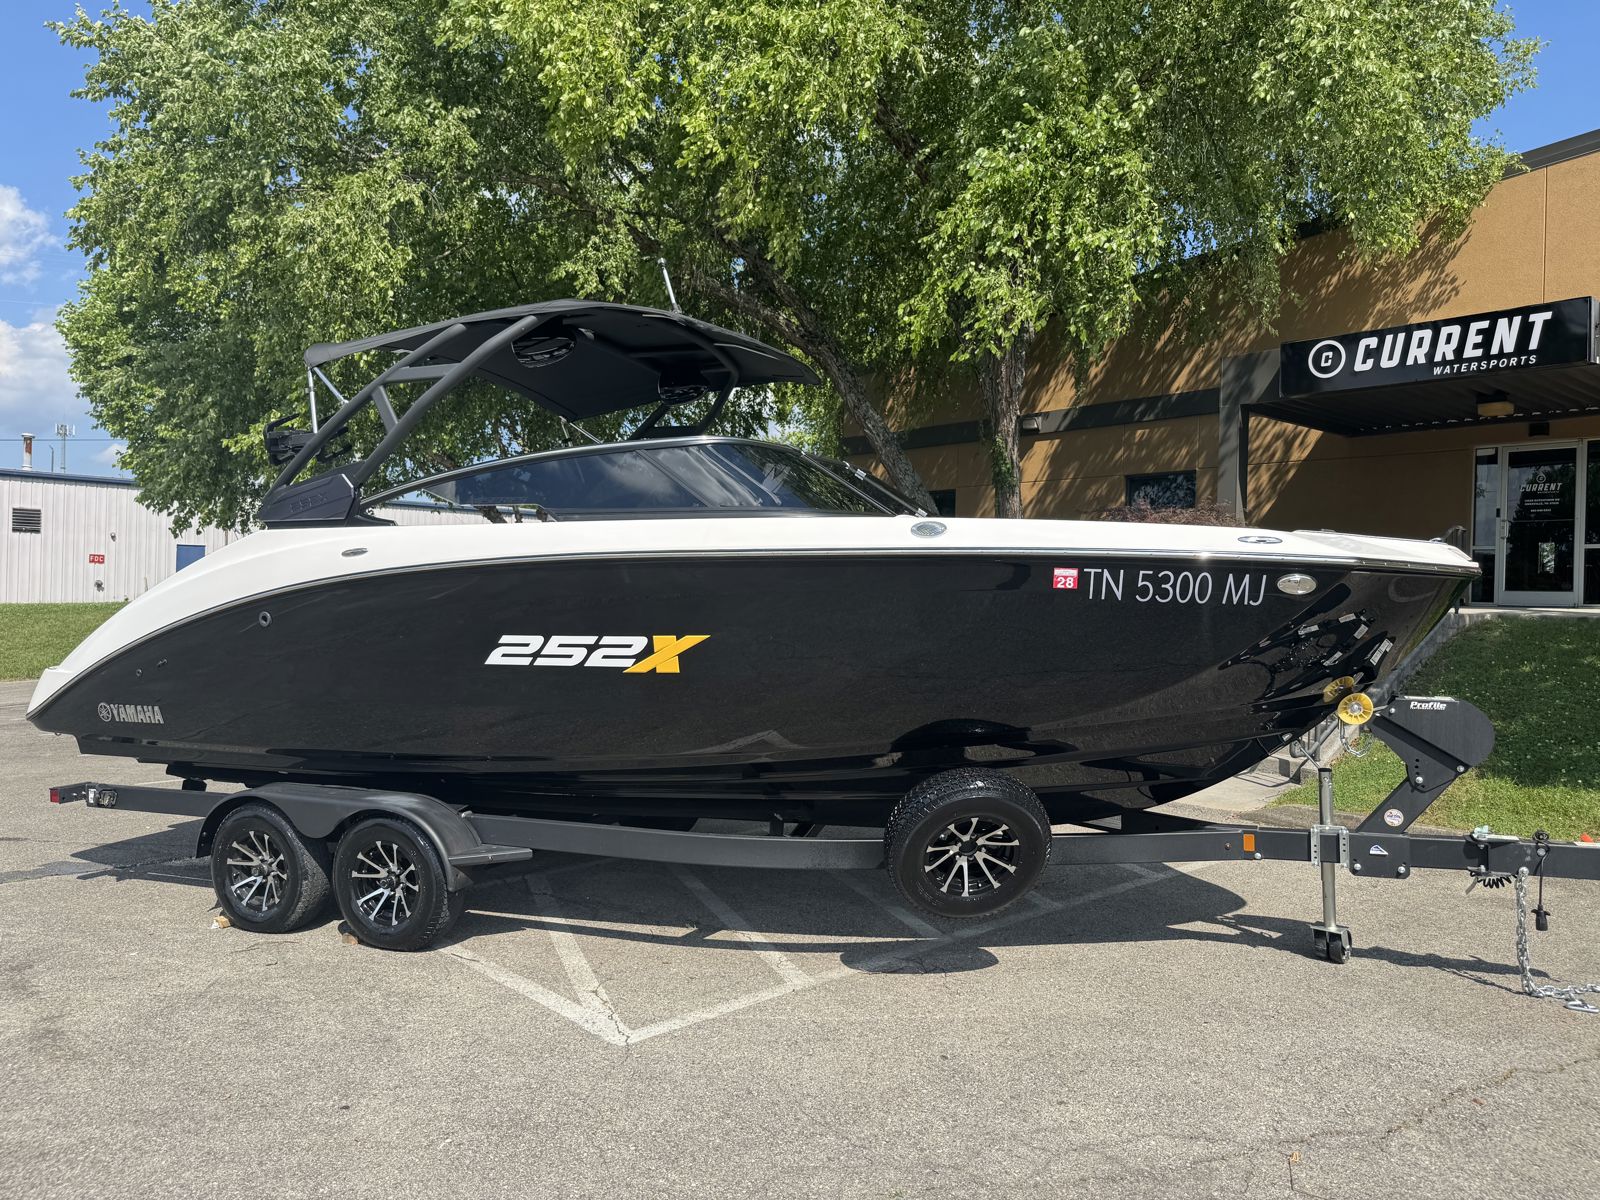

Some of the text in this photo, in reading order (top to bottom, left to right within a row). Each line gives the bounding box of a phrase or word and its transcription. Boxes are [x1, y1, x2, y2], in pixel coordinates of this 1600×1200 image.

[1353, 311, 1553, 372] CURRENT
[1433, 354, 1537, 376] WATERSPORTS
[1519, 482, 1563, 492] CURRENT
[1056, 576, 1074, 588] 28
[1083, 568, 1267, 606] TN 5300 MJ
[484, 634, 712, 674] 252X
[109, 703, 165, 724] YAMAHA
[1410, 701, 1447, 709] Profile
